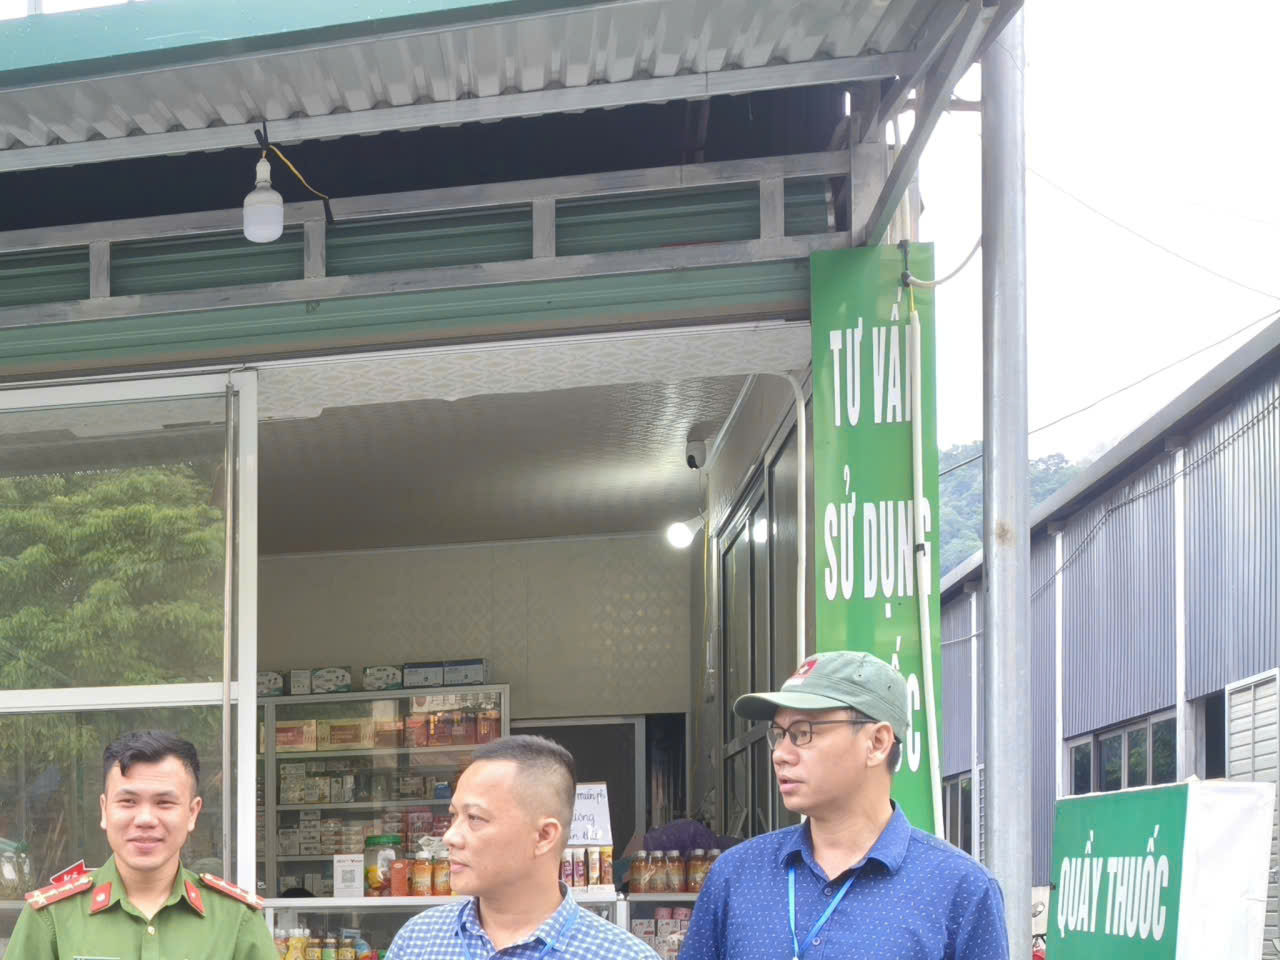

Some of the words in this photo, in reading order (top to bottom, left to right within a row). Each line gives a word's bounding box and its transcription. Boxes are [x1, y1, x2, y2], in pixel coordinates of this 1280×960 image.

[830, 317, 863, 426] TƯ
[824, 464, 856, 600] SỬ
[864, 497, 932, 618] DỤNG
[1057, 830, 1104, 938] QUẦY
[1105, 824, 1169, 940] THUỐC
